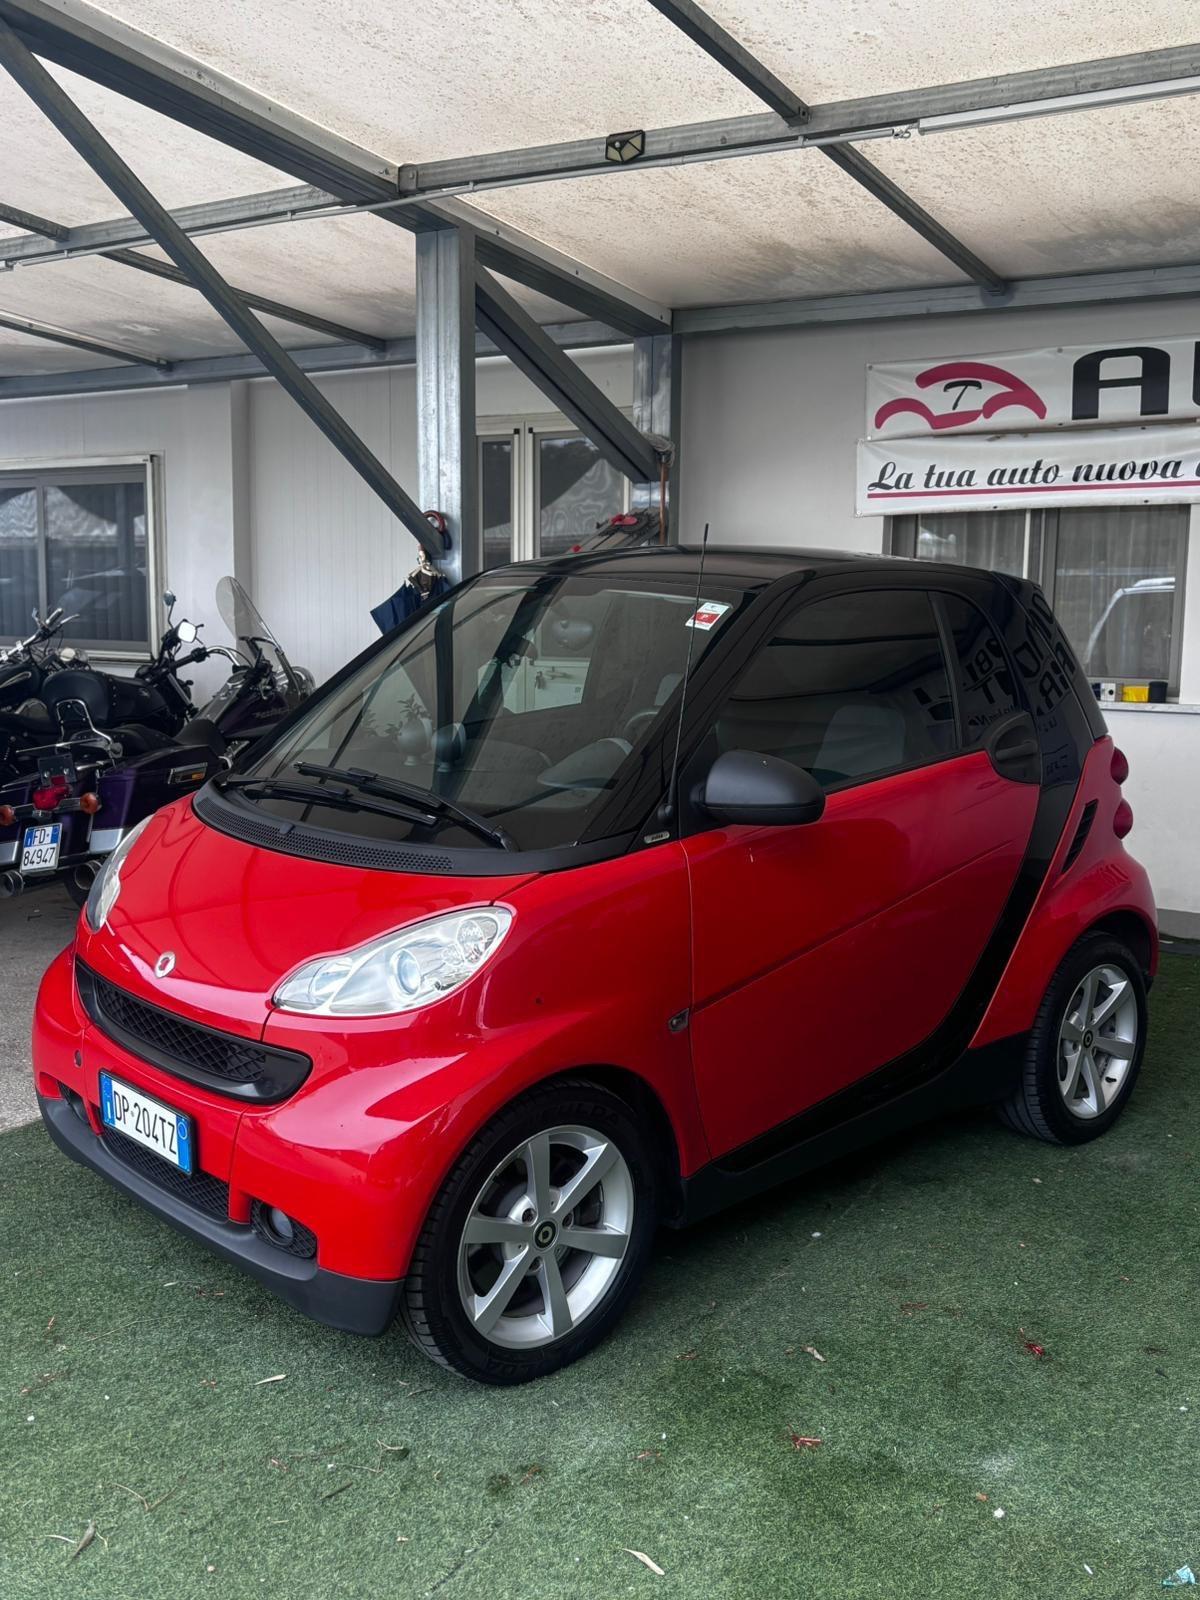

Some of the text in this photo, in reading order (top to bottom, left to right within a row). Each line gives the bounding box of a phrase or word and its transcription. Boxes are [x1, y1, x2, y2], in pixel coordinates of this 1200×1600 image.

[1072, 342, 1200, 420] A
[868, 461, 914, 491] La
[924, 463, 977, 489] tua
[987, 459, 1064, 486] auto
[1072, 457, 1184, 482] nuova
[24, 847, 55, 866] 84947
